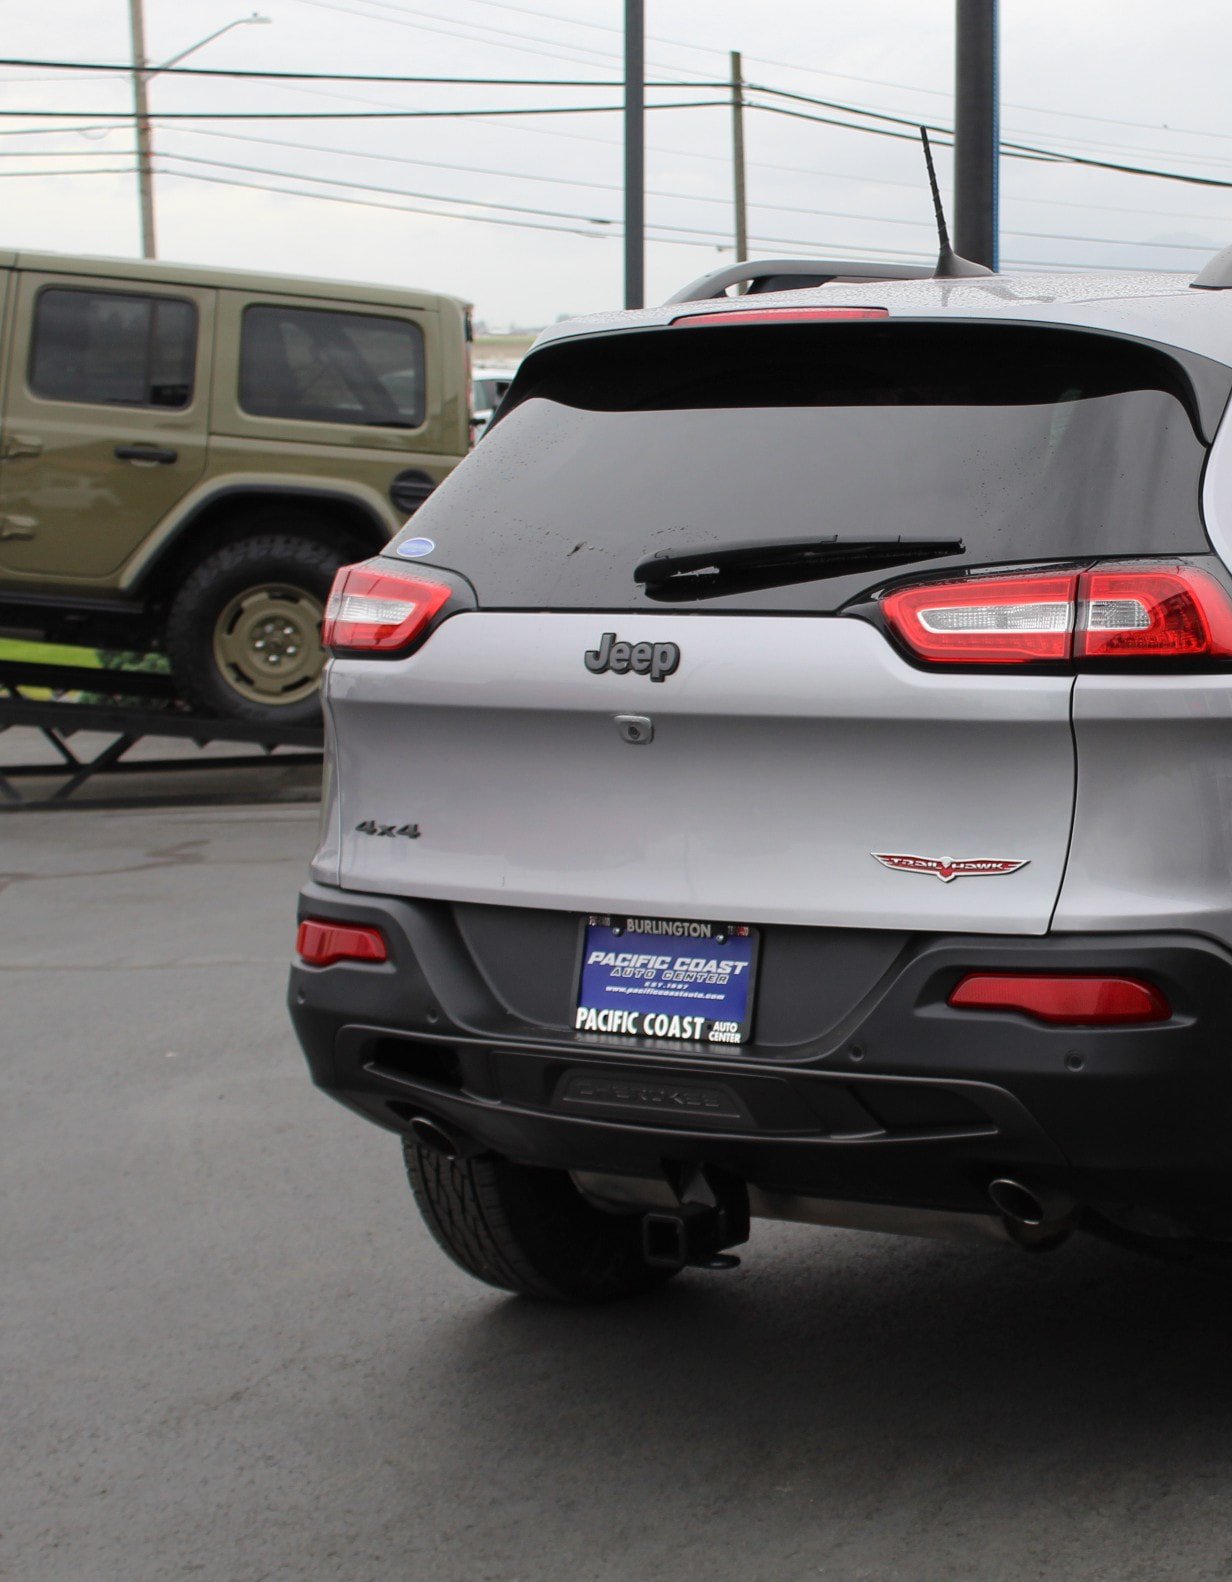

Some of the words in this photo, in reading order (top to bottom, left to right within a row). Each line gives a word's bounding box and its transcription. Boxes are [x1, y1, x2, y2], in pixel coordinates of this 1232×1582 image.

[584, 632, 680, 682] Jeep
[355, 820, 421, 839] 4x4
[626, 918, 711, 938] BURLINGTON
[587, 951, 672, 970] PACIFIC
[673, 957, 749, 975] COAST
[610, 967, 656, 979] AUTO
[661, 971, 729, 984] CENTER
[575, 1006, 640, 1035] PACIFIC
[643, 1012, 705, 1040] COAST
[712, 1021, 738, 1032] AUTO
[708, 1031, 741, 1044] CENTER
